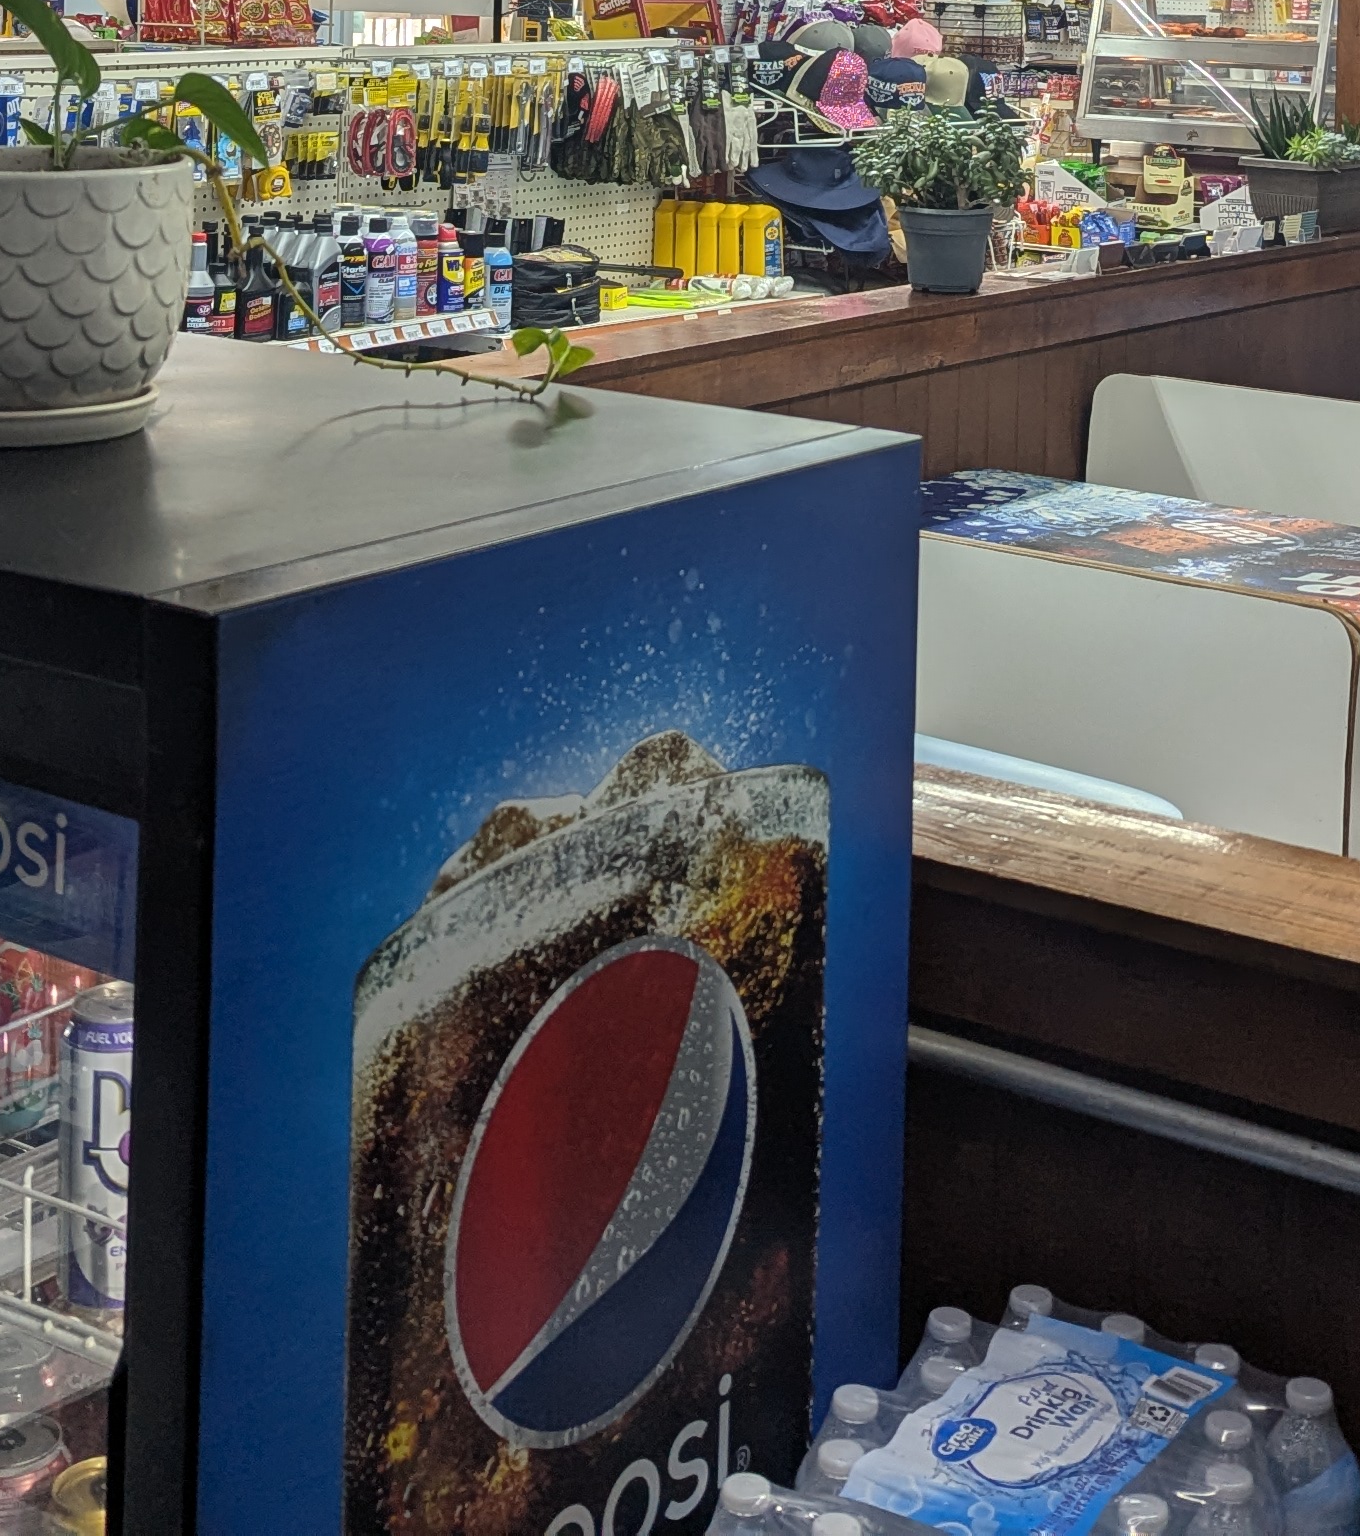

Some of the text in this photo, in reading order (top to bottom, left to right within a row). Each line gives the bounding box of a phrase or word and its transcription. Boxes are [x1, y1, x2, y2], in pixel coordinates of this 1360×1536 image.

[753, 60, 785, 71] TEXAS
[867, 75, 898, 93] TEXAS
[1218, 204, 1254, 213] PICKLE
[1218, 217, 1256, 227] POUCH
[85, 1031, 111, 1045] FUEL
[543, 1373, 733, 1536] psi
